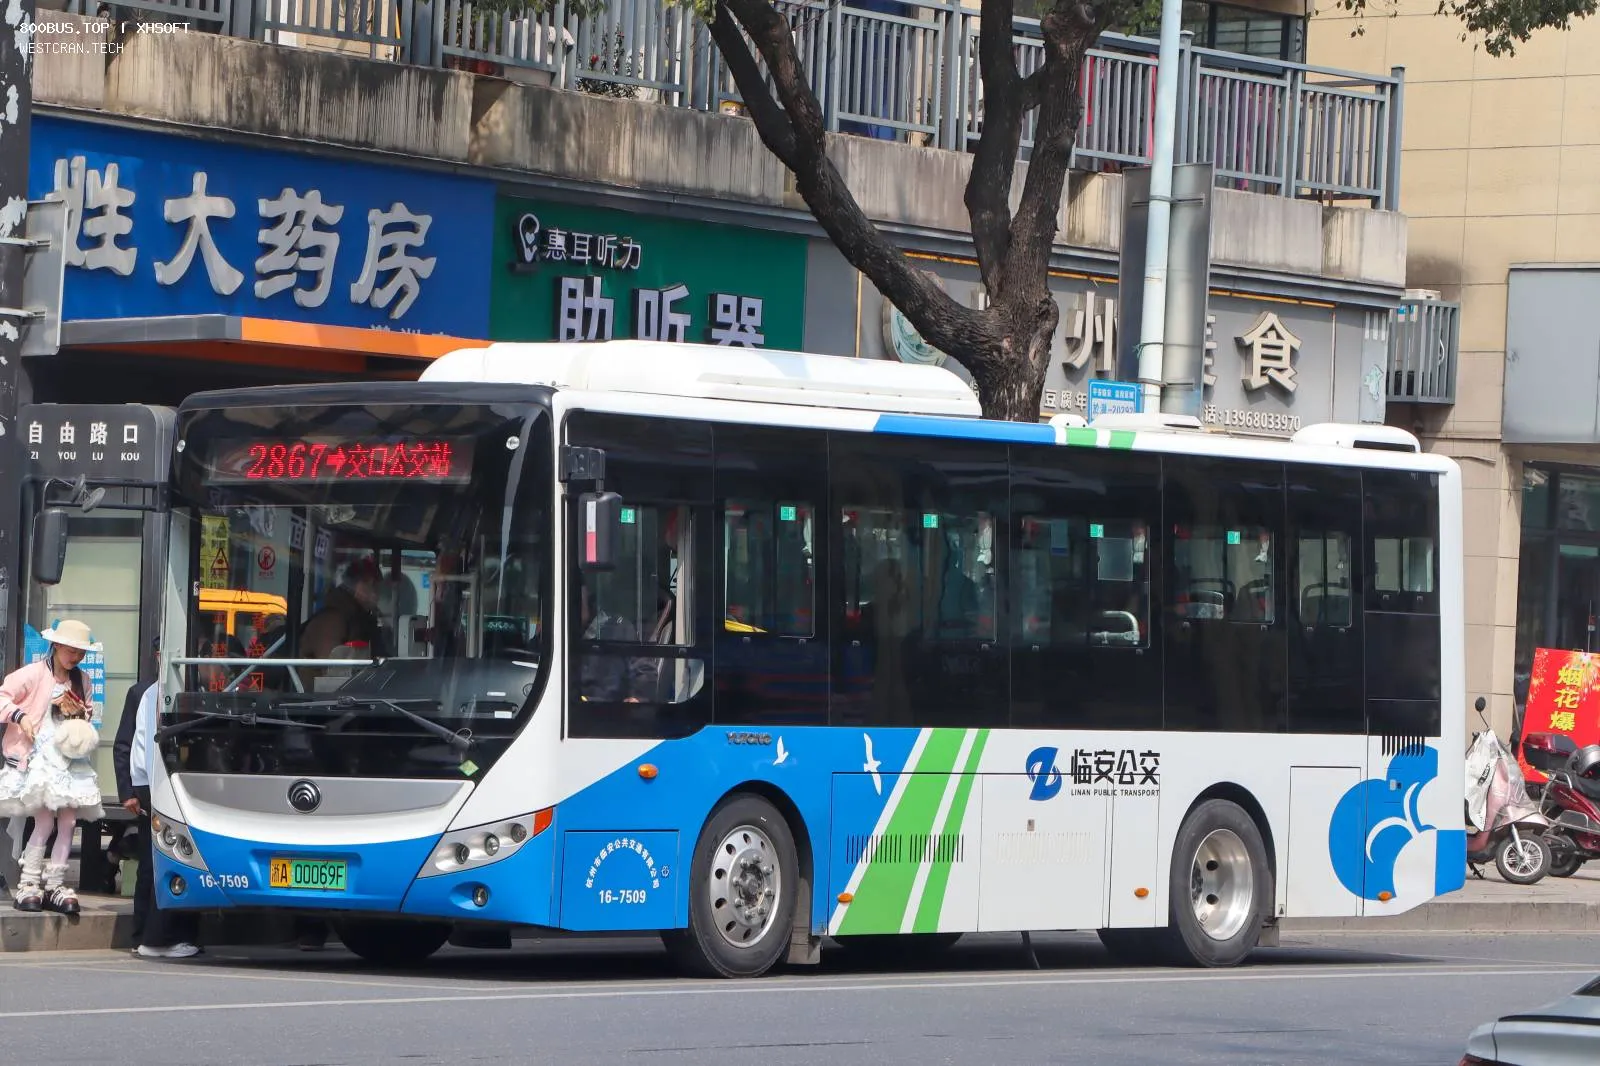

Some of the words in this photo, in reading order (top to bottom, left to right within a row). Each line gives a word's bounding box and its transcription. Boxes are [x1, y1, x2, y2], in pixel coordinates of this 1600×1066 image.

[545, 228, 642, 271] 惠耳听力
[28, 420, 138, 444] 自由路口
[30, 451, 39, 460] ZI
[58, 451, 77, 461] YOU
[92, 452, 104, 461] LU
[120, 452, 140, 461] KOU
[1070, 748, 1161, 785] 临安公交
[1070, 788, 1091, 796] LINAN
[1093, 788, 1118, 797] PUBLIC
[1120, 789, 1160, 797] TRANSPORT
[199, 873, 249, 889] 16-7509
[599, 889, 646, 904] 16-7509
